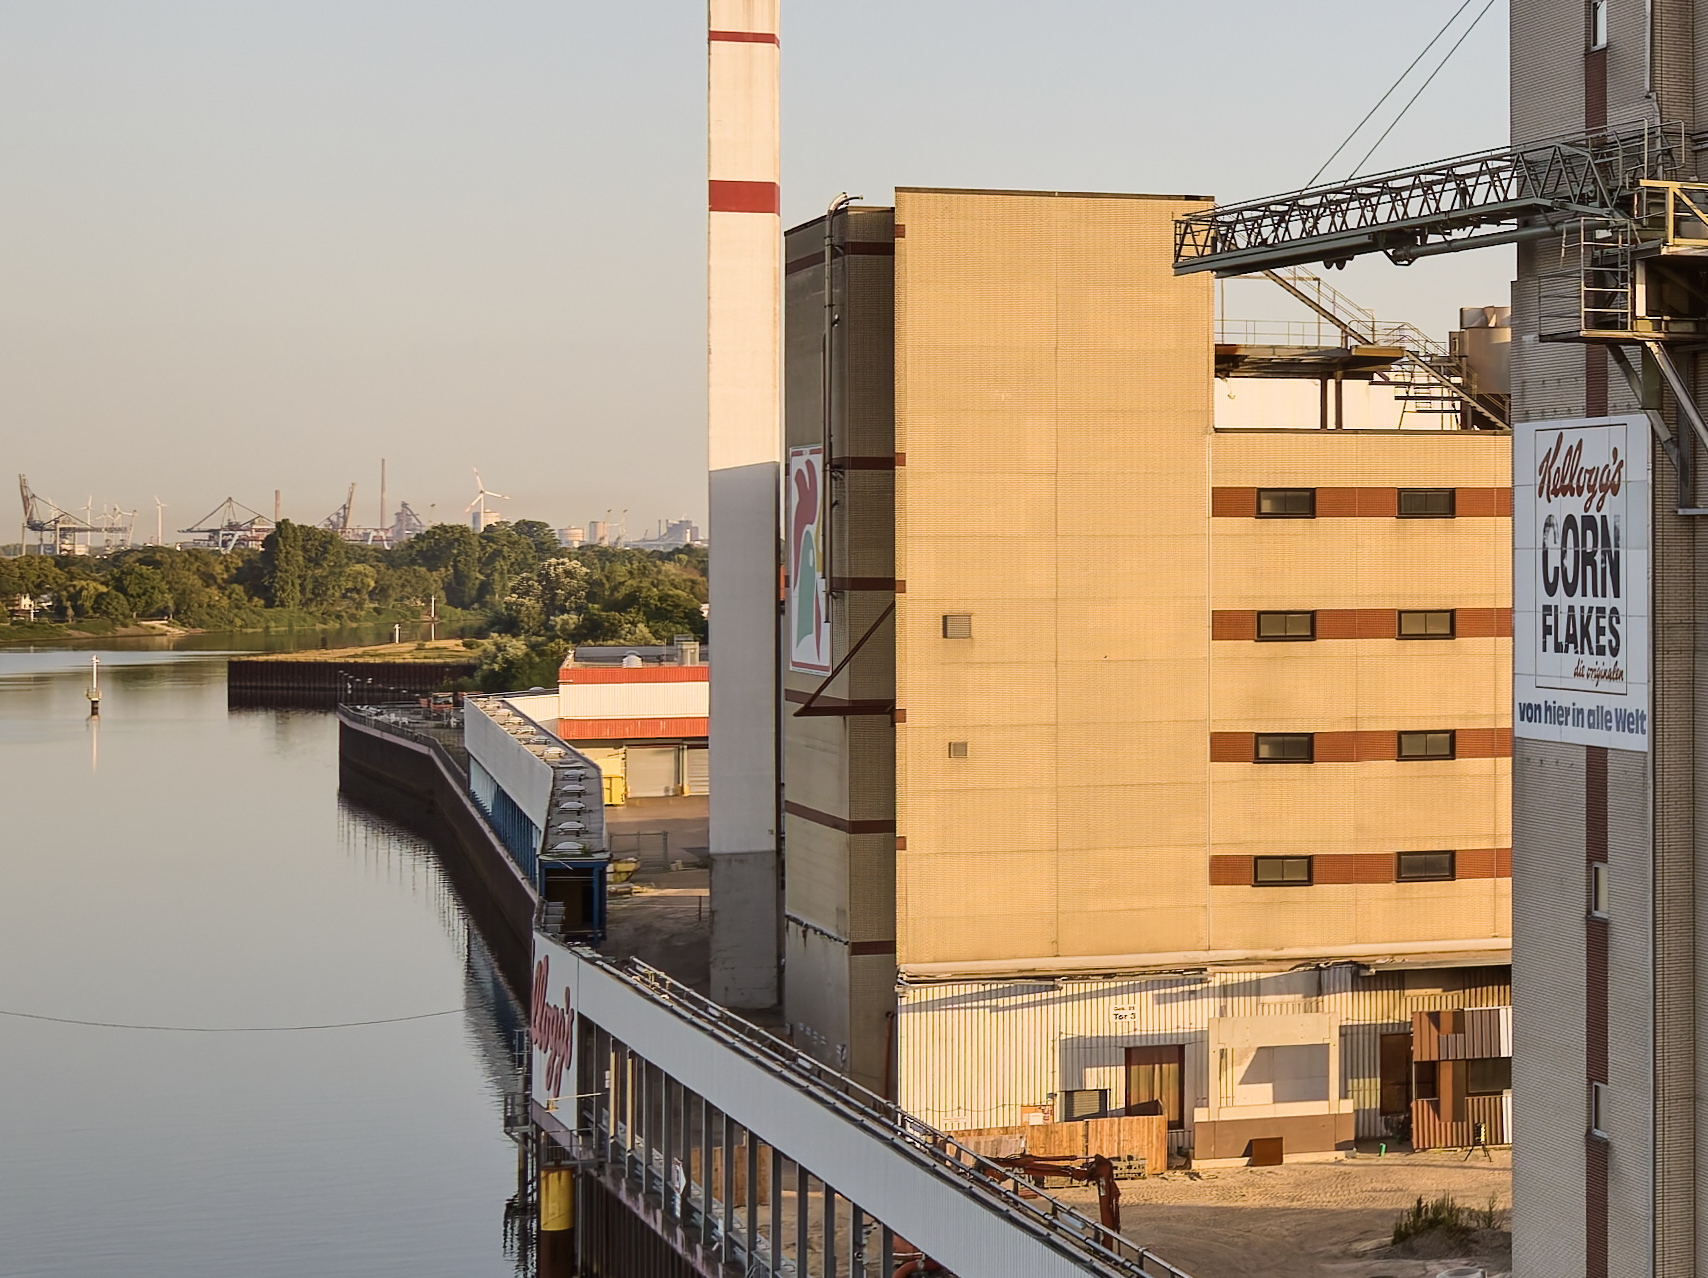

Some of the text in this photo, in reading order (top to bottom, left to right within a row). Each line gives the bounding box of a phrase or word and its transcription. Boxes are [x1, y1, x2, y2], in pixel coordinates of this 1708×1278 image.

[1537, 431, 1624, 513] Kellogg's
[1541, 514, 1620, 599] CORN
[1541, 604, 1620, 659] FLAKES
[1573, 657, 1624, 687] die originalen
[1518, 701, 1647, 736] von hier in alle Welt
